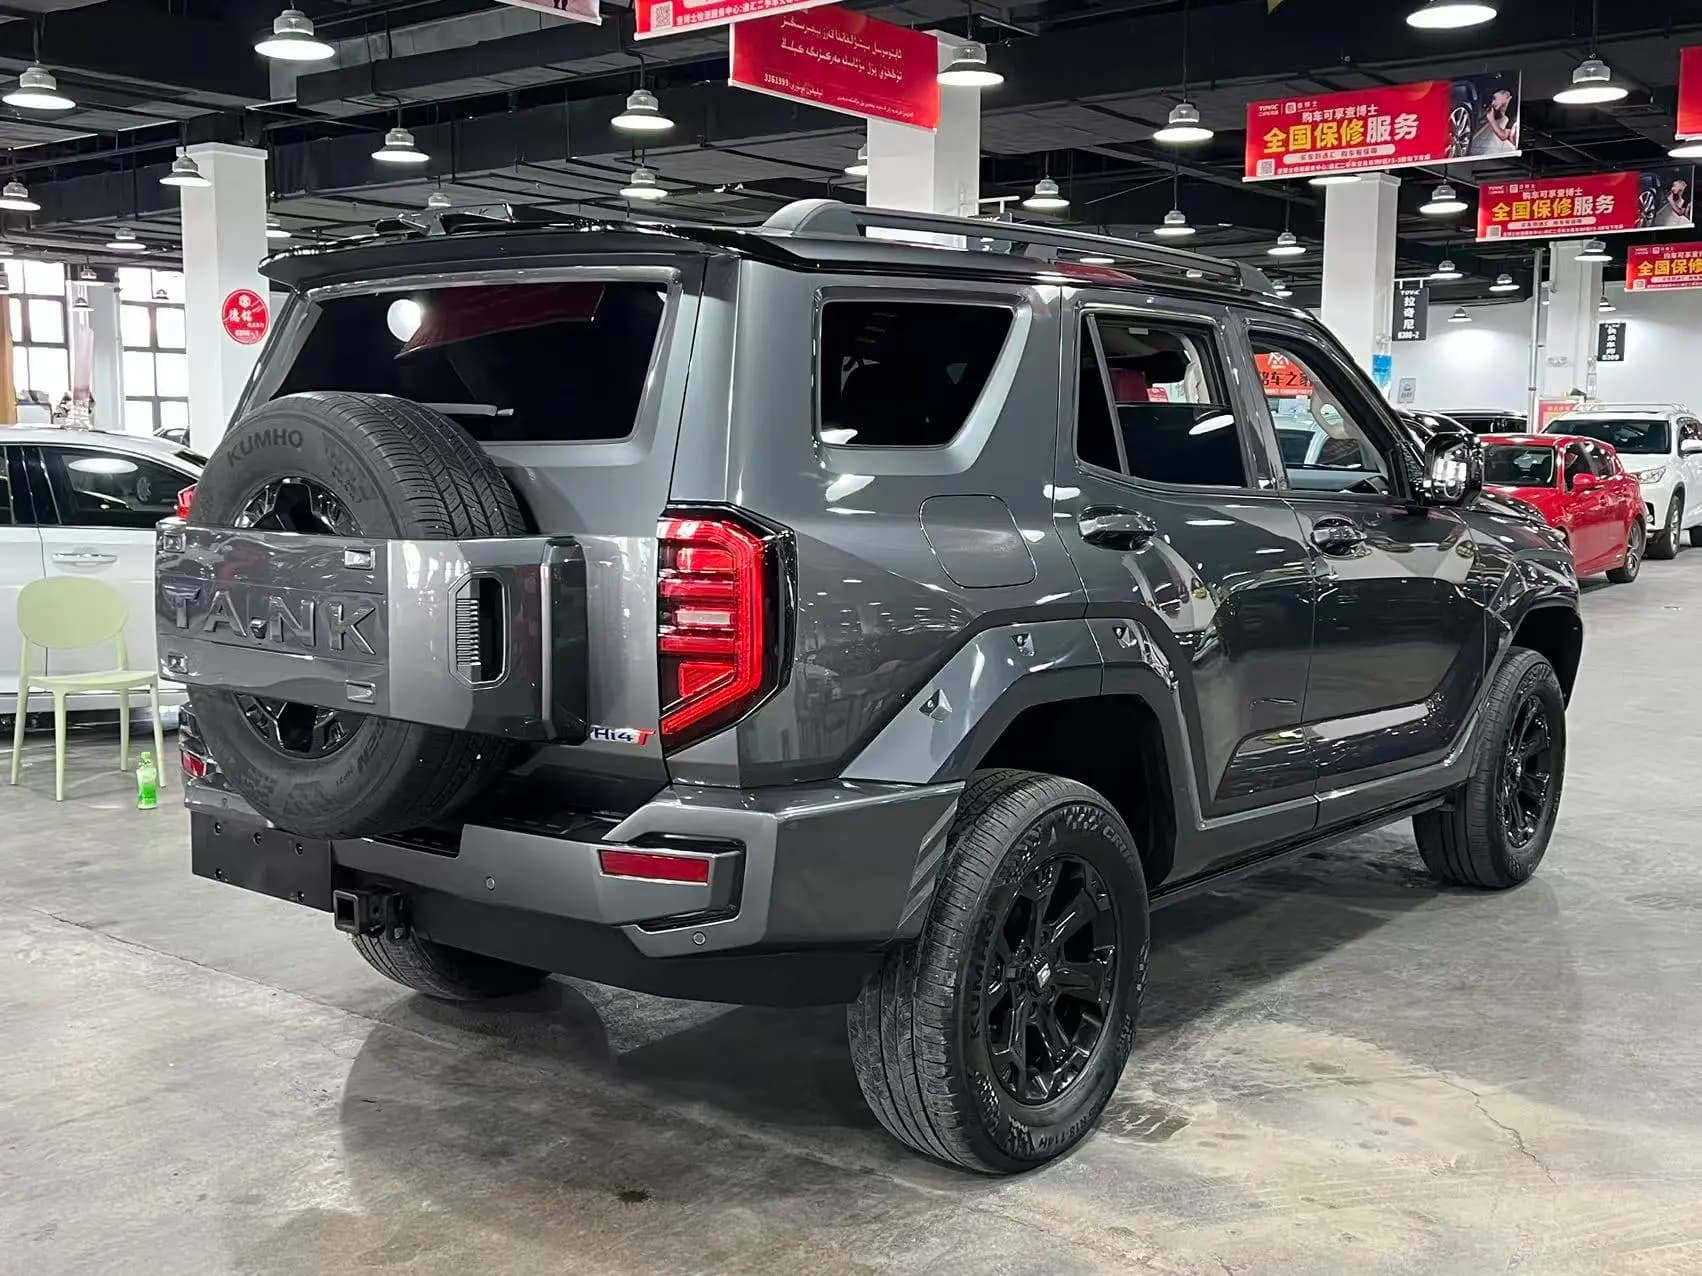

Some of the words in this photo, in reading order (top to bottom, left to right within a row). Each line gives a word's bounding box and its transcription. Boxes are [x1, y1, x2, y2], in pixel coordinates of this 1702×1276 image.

[1263, 112, 1419, 154] 全国保修服务
[1302, 104, 1379, 123] 购车可享查博士
[1491, 194, 1615, 222] 全国保修服务
[226, 428, 304, 467] KUMHO
[163, 584, 376, 655] TANK
